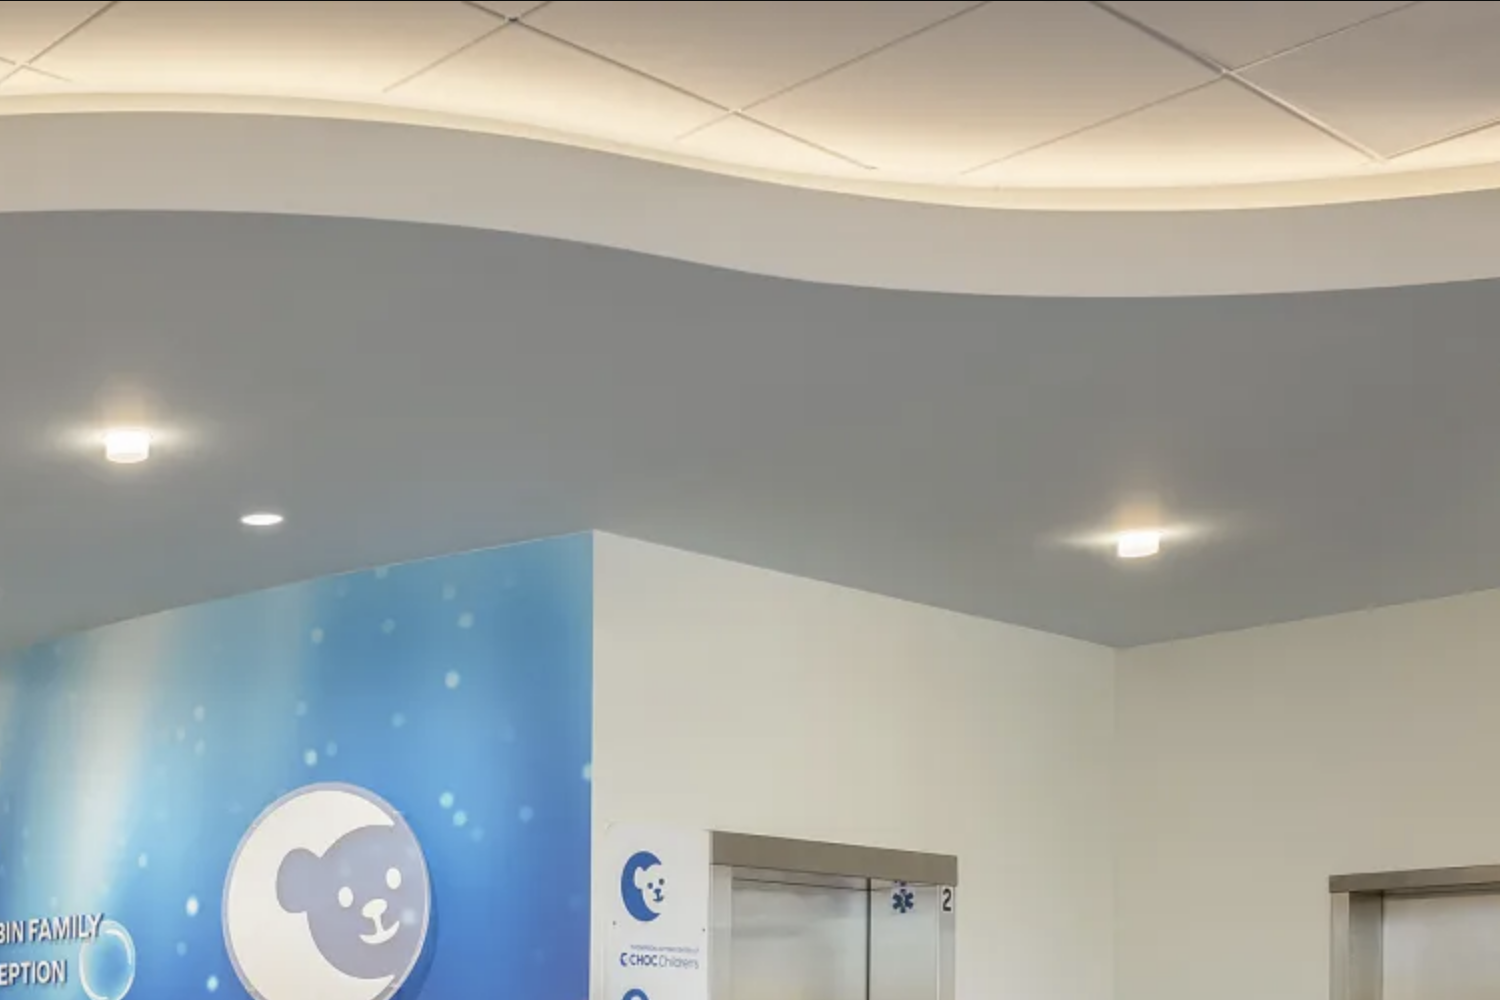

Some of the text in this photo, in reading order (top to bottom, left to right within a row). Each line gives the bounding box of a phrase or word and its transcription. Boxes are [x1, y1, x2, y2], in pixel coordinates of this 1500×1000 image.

[942, 888, 952, 911] 2
[29, 913, 104, 942] FAMILY
[629, 954, 658, 966] CHOC
